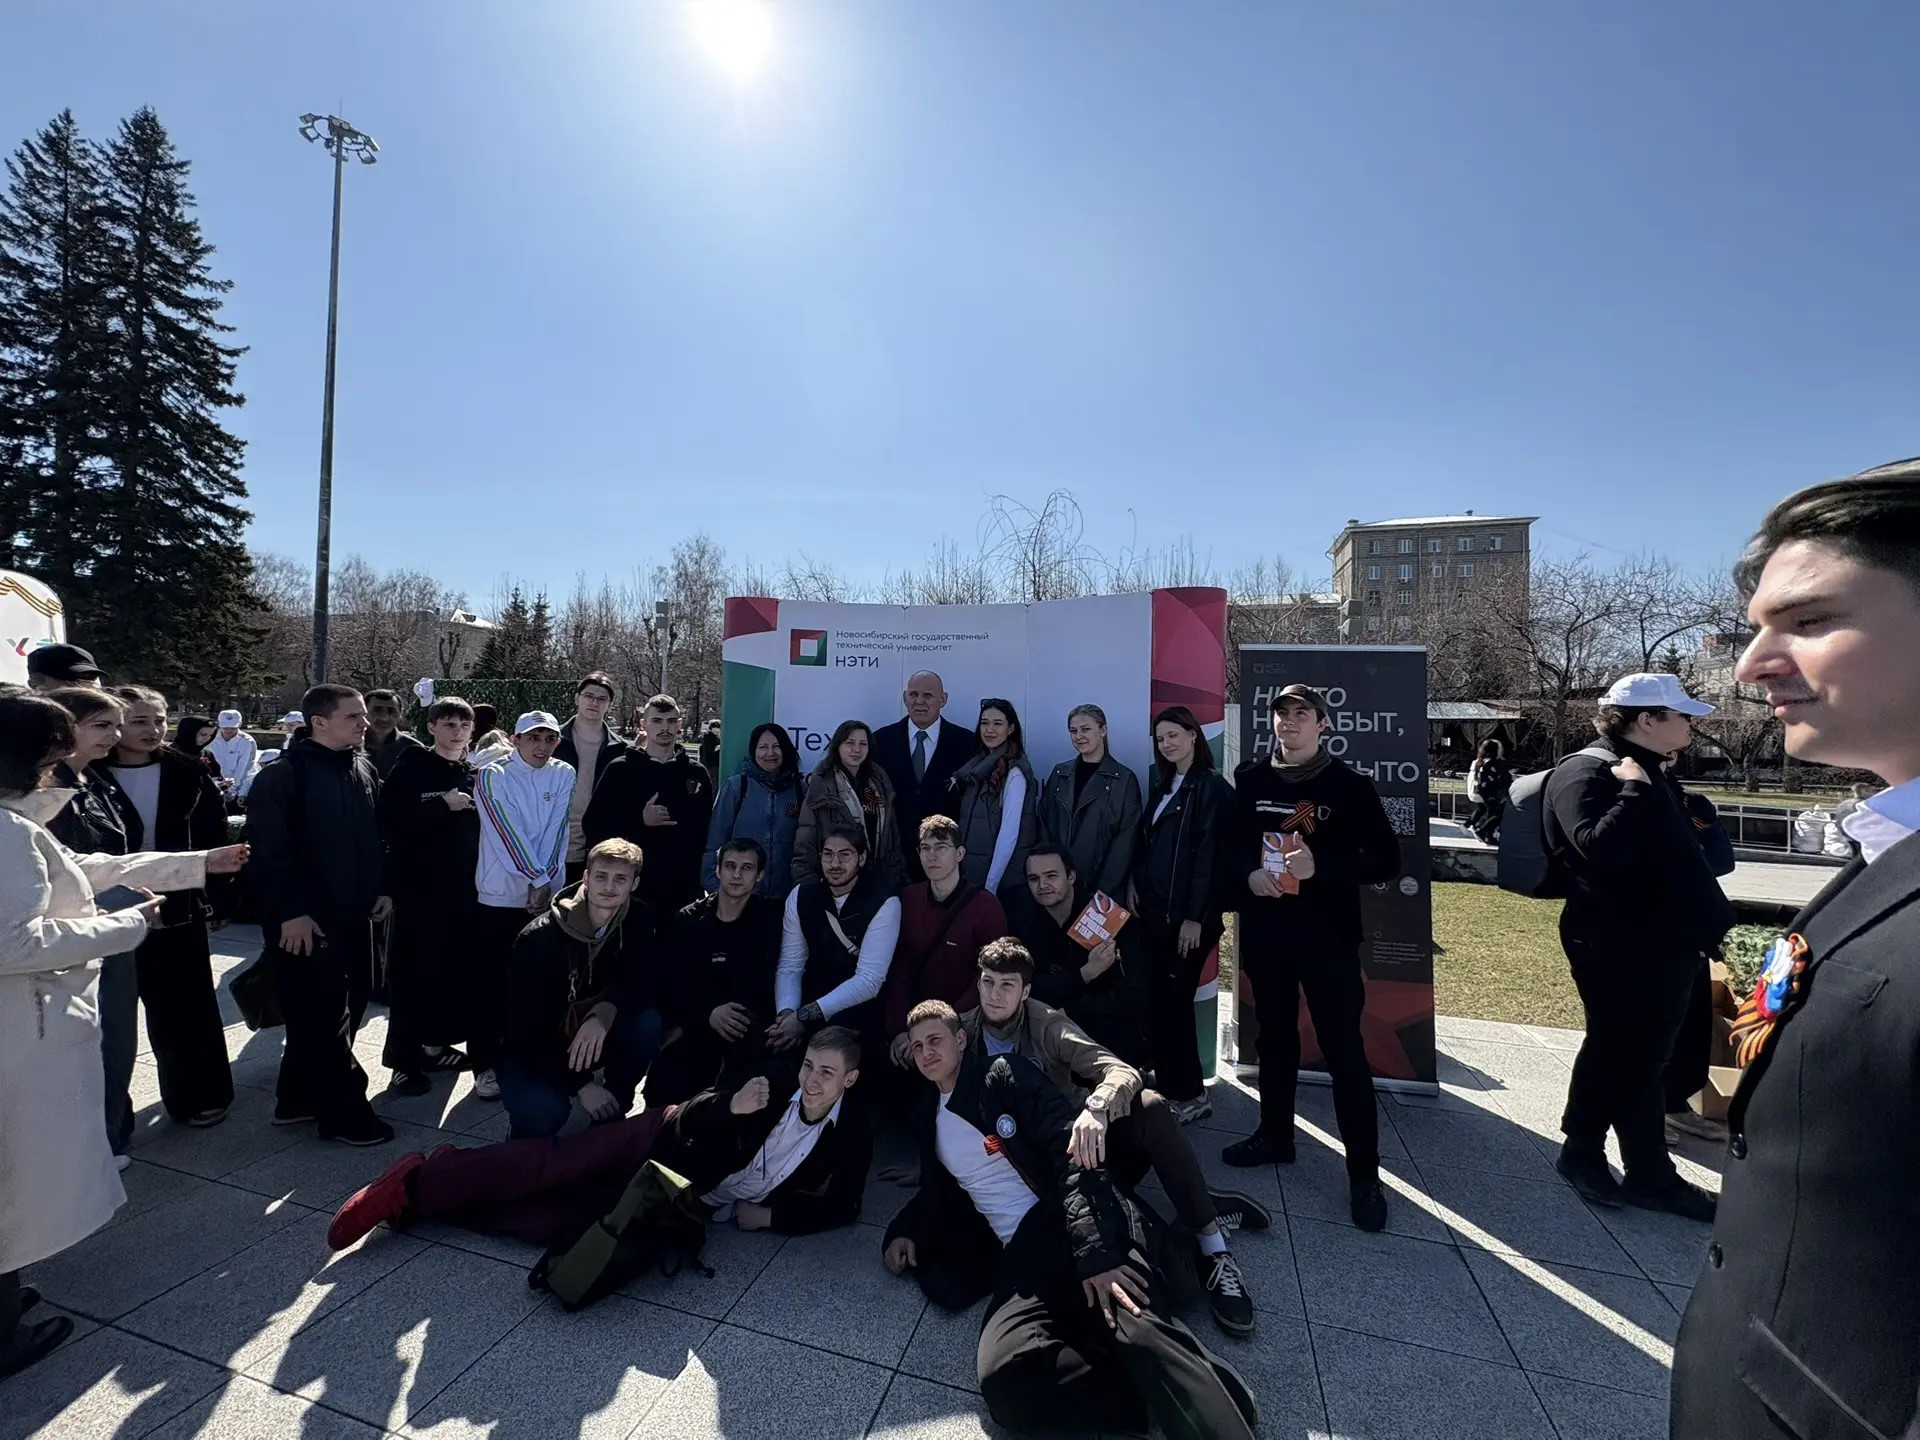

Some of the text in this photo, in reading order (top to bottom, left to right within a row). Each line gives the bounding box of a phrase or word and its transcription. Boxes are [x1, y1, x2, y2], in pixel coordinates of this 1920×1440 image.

[836, 630, 989, 642] Новосибирский государственный
[836, 642, 953, 652] технический университет
[835, 655, 879, 668] НЭТИ
[1326, 711, 1404, 736] АБЫТ,
